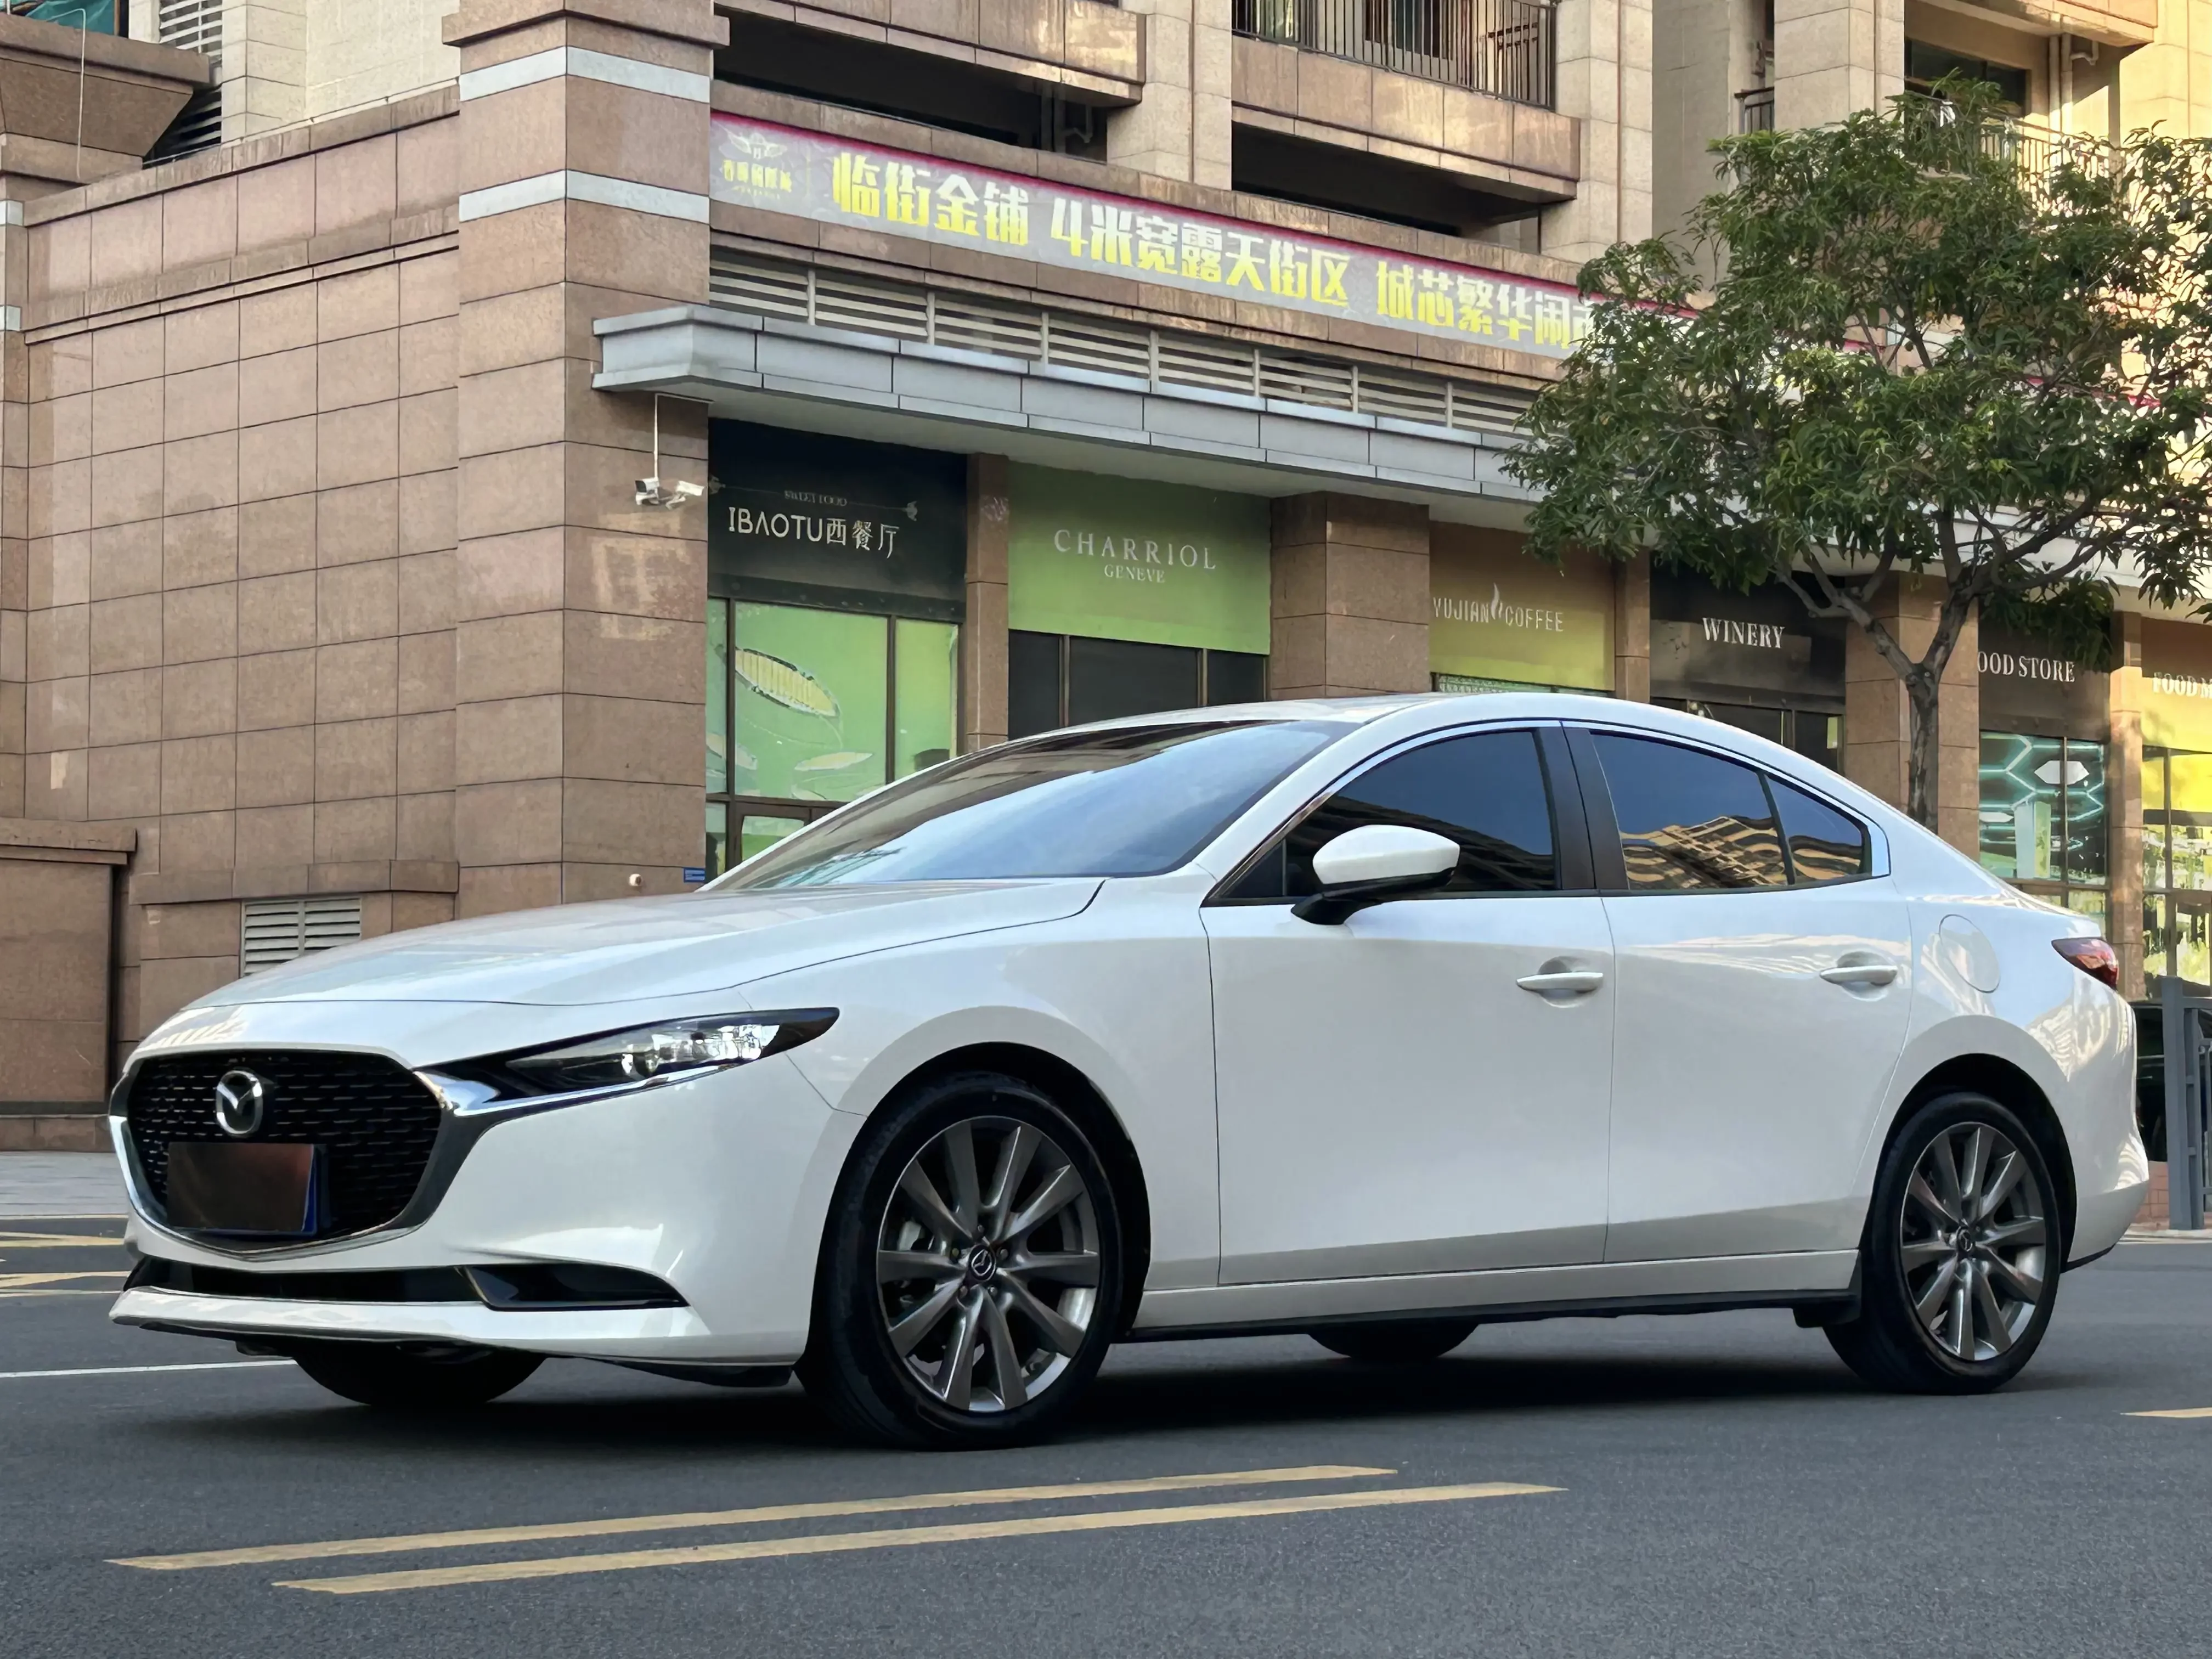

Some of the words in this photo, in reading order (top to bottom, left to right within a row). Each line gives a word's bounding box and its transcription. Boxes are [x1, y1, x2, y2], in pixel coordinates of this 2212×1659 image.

[833, 152, 1029, 246] 临街金铺
[1051, 196, 1351, 306] 4米宽露天街区
[1054, 529, 1216, 569] CHARRIOL
[1104, 564, 1165, 583] GENEVE
[1434, 597, 1489, 623] YUJIAN
[1505, 606, 1563, 631] COFFEE
[1702, 617, 1785, 649] WINERY
[1977, 651, 2014, 675] OOD
[2018, 656, 2075, 682] STORE
[2153, 672, 2198, 697] FOOD
